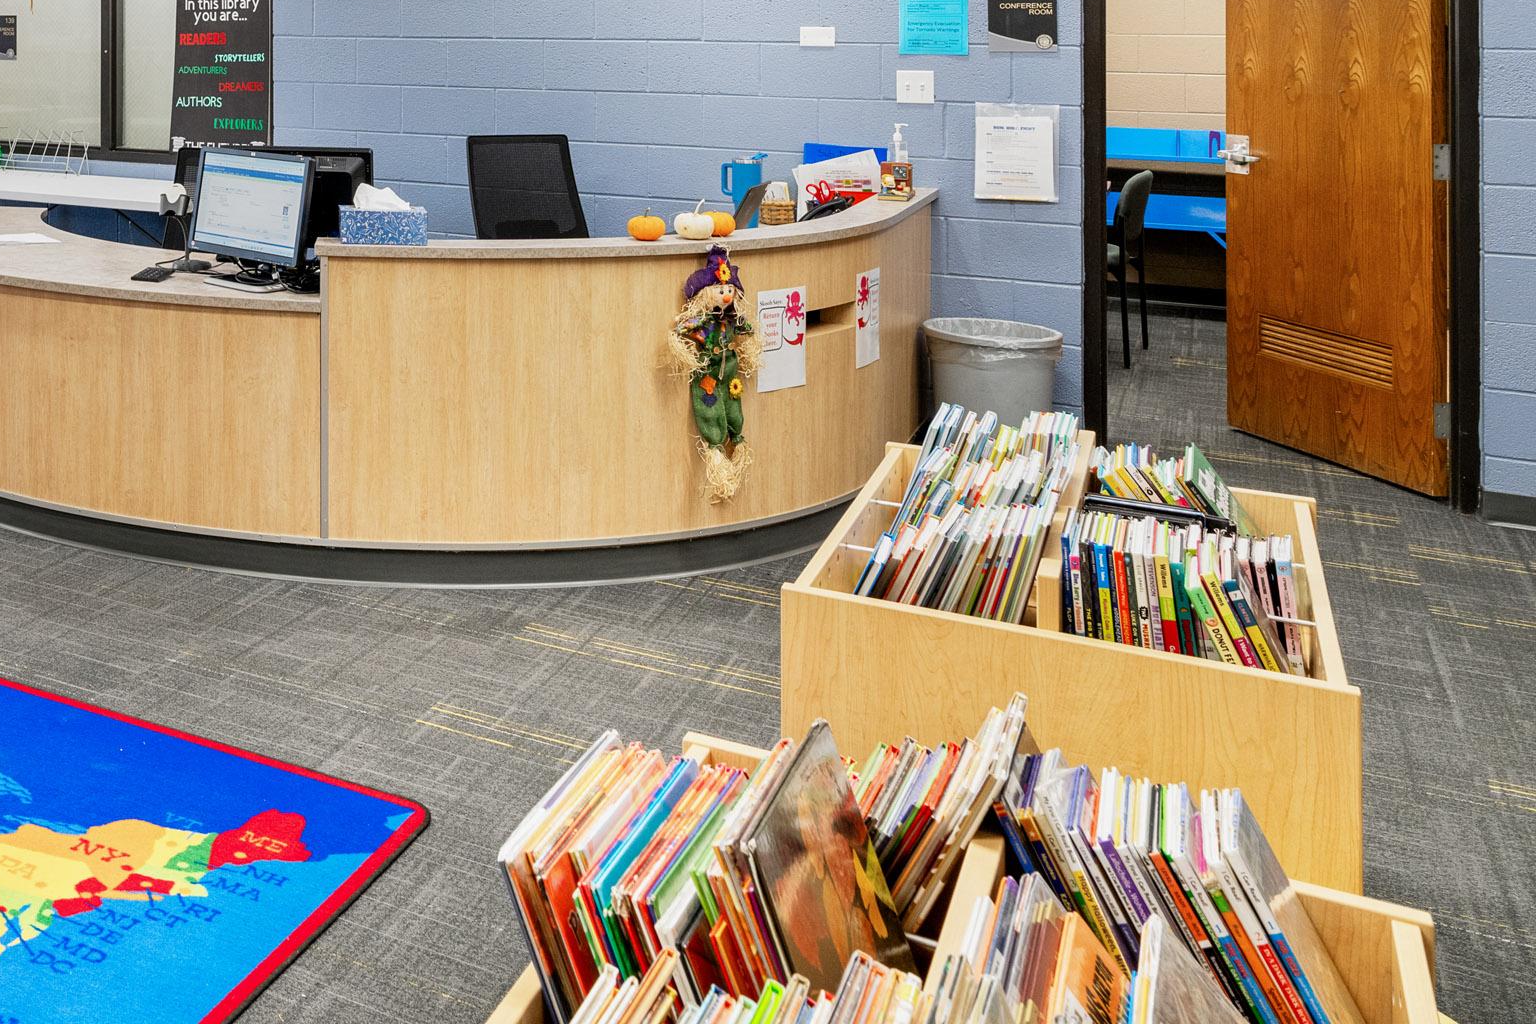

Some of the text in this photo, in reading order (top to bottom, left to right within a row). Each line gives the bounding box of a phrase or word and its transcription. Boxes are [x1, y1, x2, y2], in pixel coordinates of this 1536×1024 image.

[194, 11, 248, 26] you are...
[180, 32, 226, 46] READERS
[214, 53, 264, 63] STORYTELLERS
[178, 66, 228, 74] ADVENTURERS
[218, 82, 264, 92] DREAMERS
[176, 96, 222, 108] AUTHORS
[214, 118, 264, 130] EXPLORERS
[1148, 470, 1164, 491] Willems
[1160, 564, 1168, 588] Willems
[1210, 581, 1224, 606] Willems
[1212, 628, 1230, 652] DONUT
[70, 837, 131, 866] NY
[239, 830, 288, 853] ME
[241, 864, 290, 887] NH
[212, 876, 260, 902] MA
[102, 908, 142, 930] NJ
[144, 908, 188, 928] CT
[182, 902, 222, 922] RI
[1078, 876, 1094, 904] Happy
[1092, 904, 1116, 952] Halloween,
[80, 922, 124, 944] DE
[52, 936, 108, 964] MD
[29, 950, 77, 974] DC
